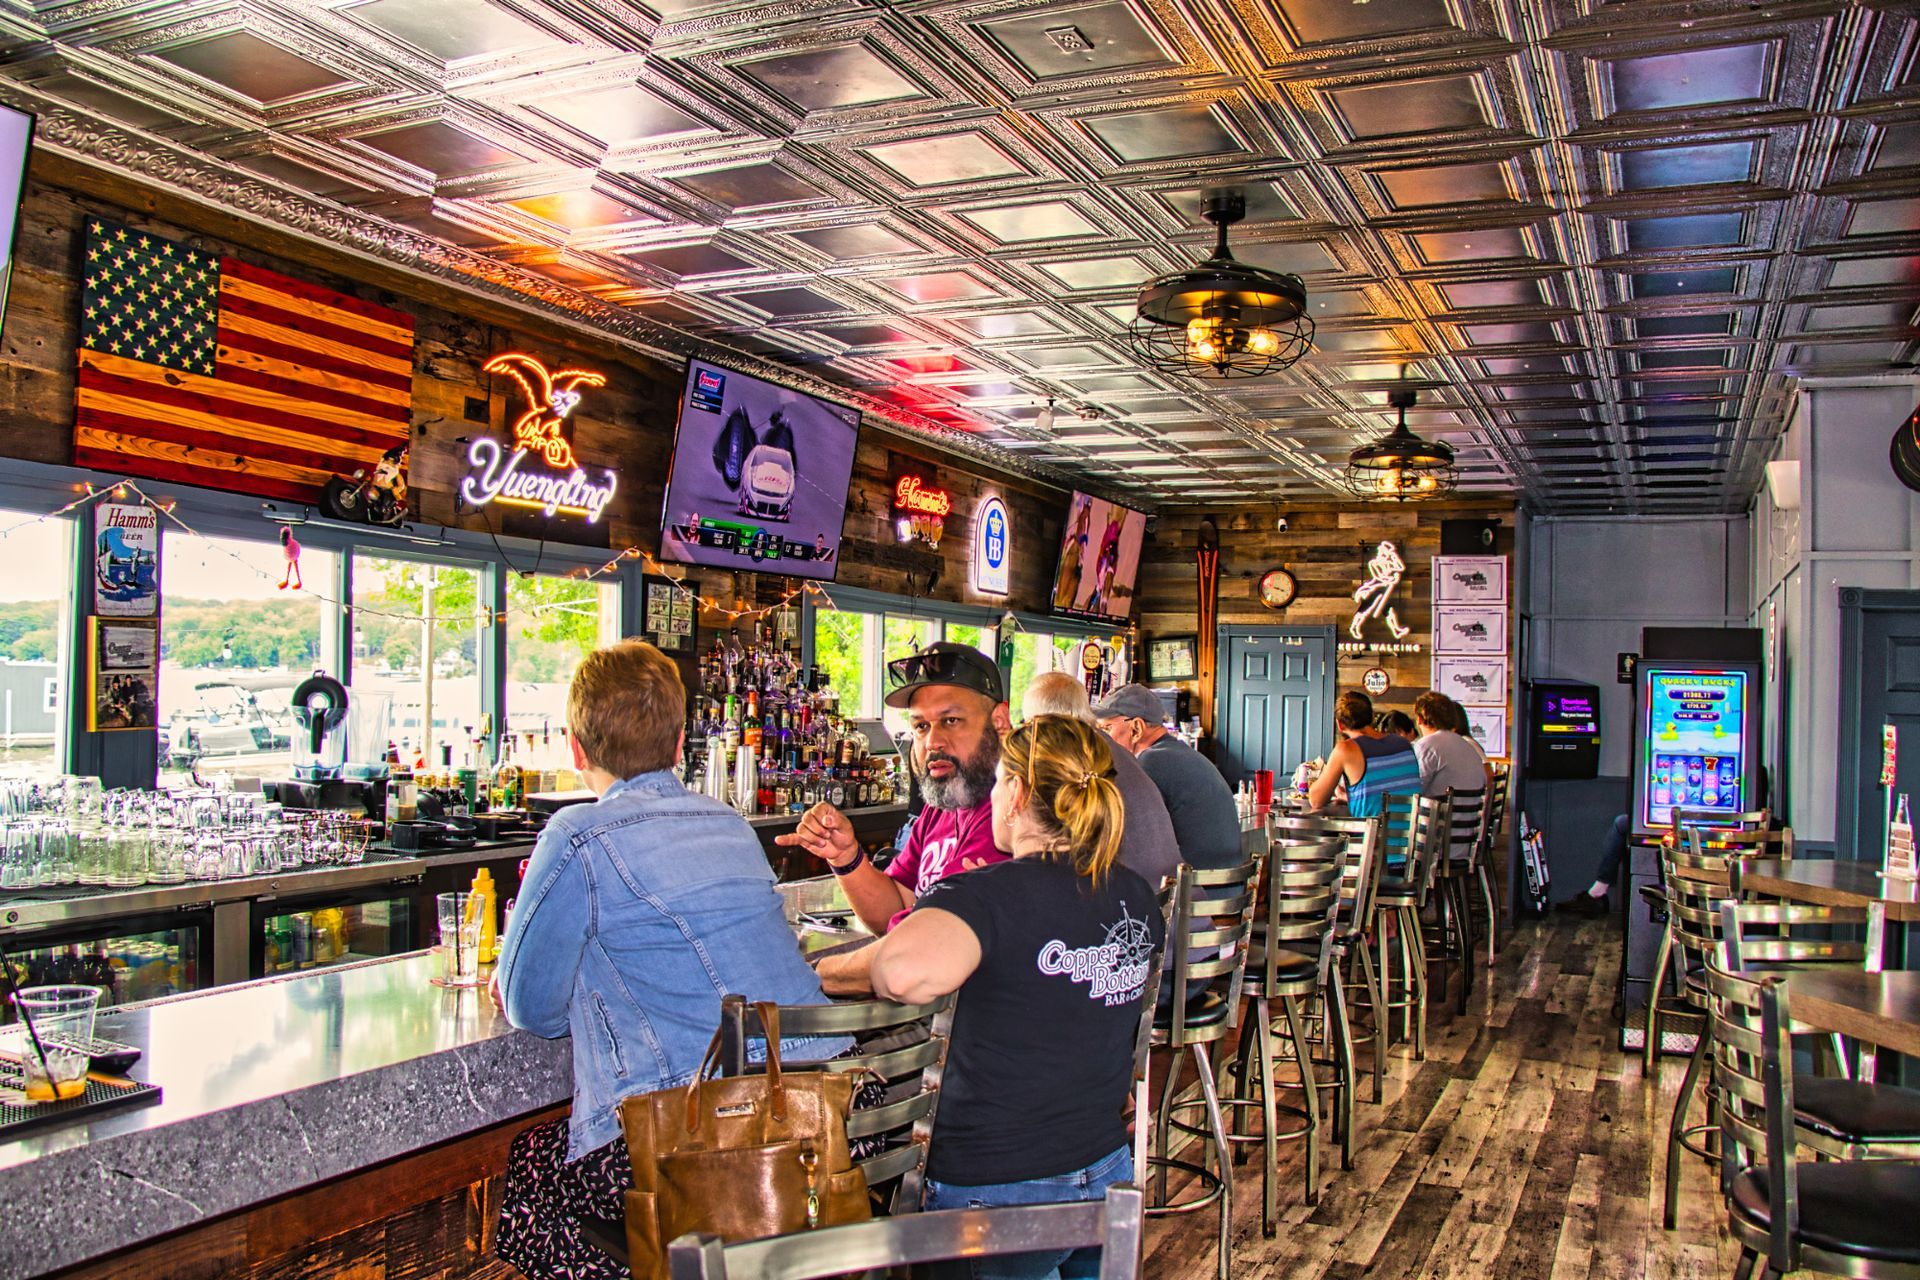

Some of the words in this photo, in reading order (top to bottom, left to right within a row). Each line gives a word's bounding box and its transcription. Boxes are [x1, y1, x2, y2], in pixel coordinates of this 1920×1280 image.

[462, 437, 618, 525] Yuengling
[895, 476, 950, 516] Hamm's
[105, 507, 156, 529] Hamm's
[119, 532, 144, 541] BEER
[1338, 643, 1366, 651] KEEP
[1370, 643, 1421, 652] WALKING
[1366, 678, 1386, 686] Julio
[1038, 939, 1119, 982] Copper
[1105, 993, 1126, 1006] BAR
